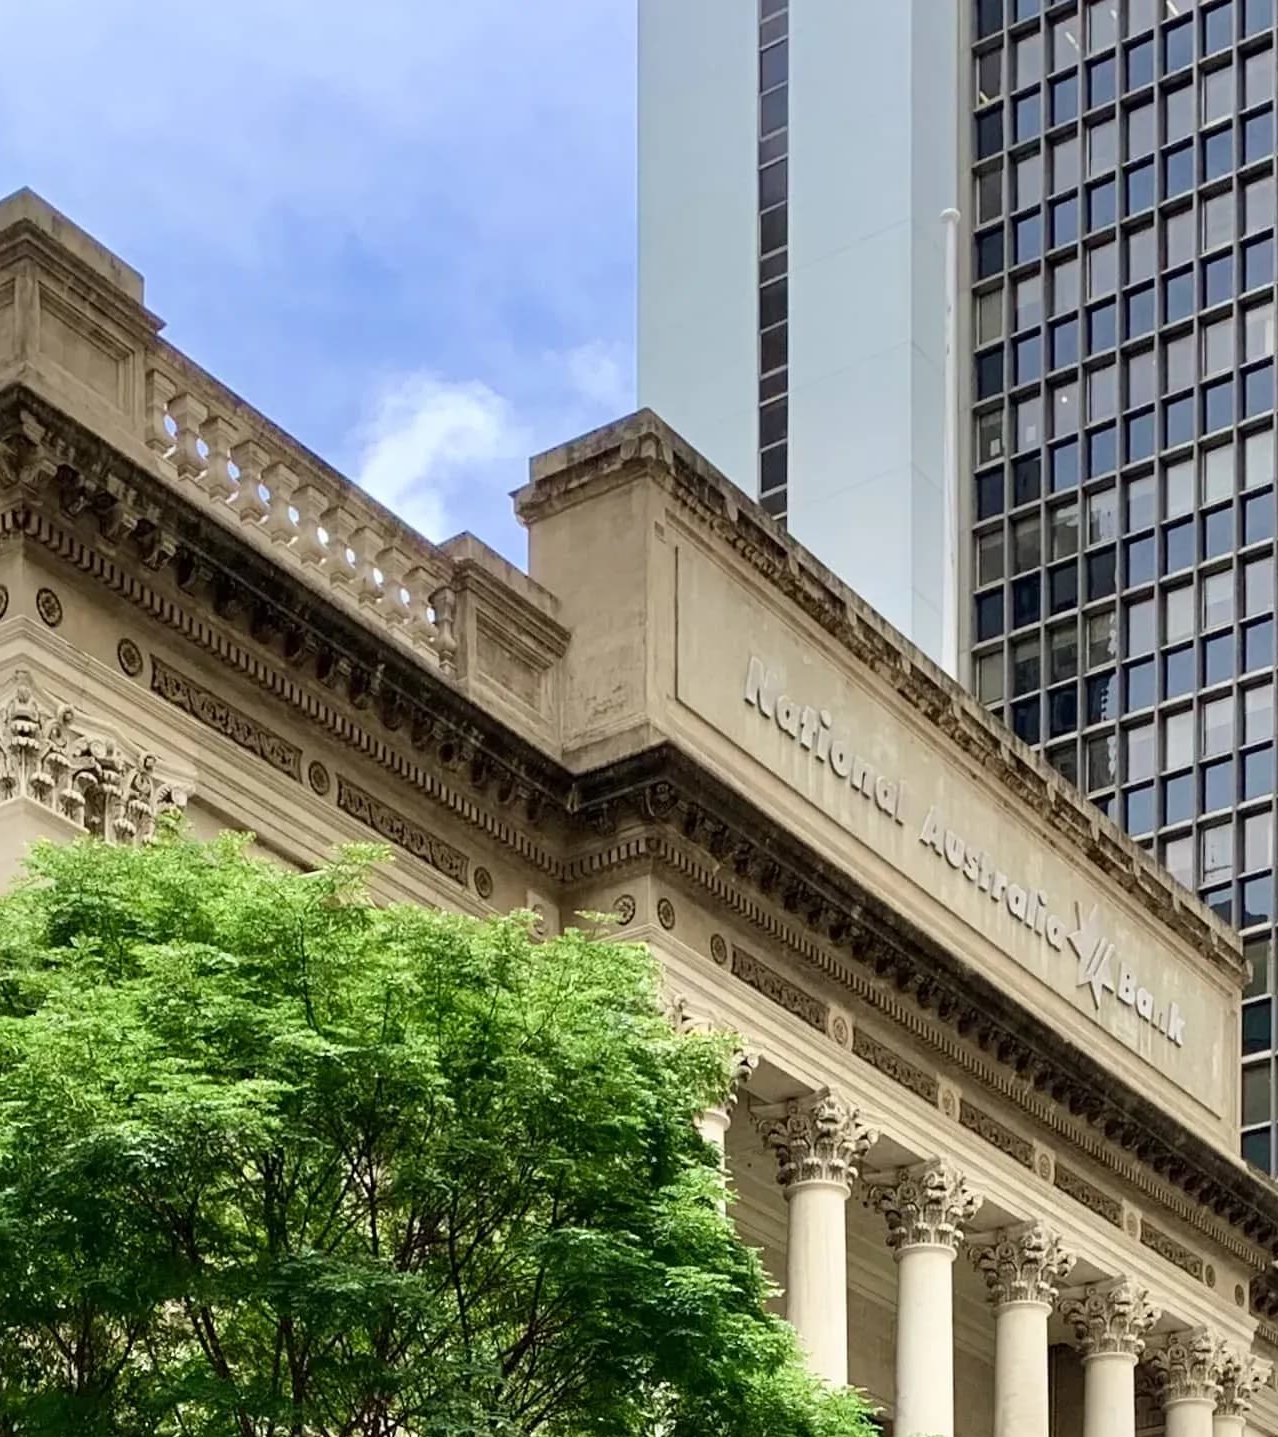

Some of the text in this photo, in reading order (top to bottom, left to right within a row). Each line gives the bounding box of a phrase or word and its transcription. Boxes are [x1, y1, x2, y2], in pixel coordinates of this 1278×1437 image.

[744, 656, 1185, 1048] National Australia Bank
